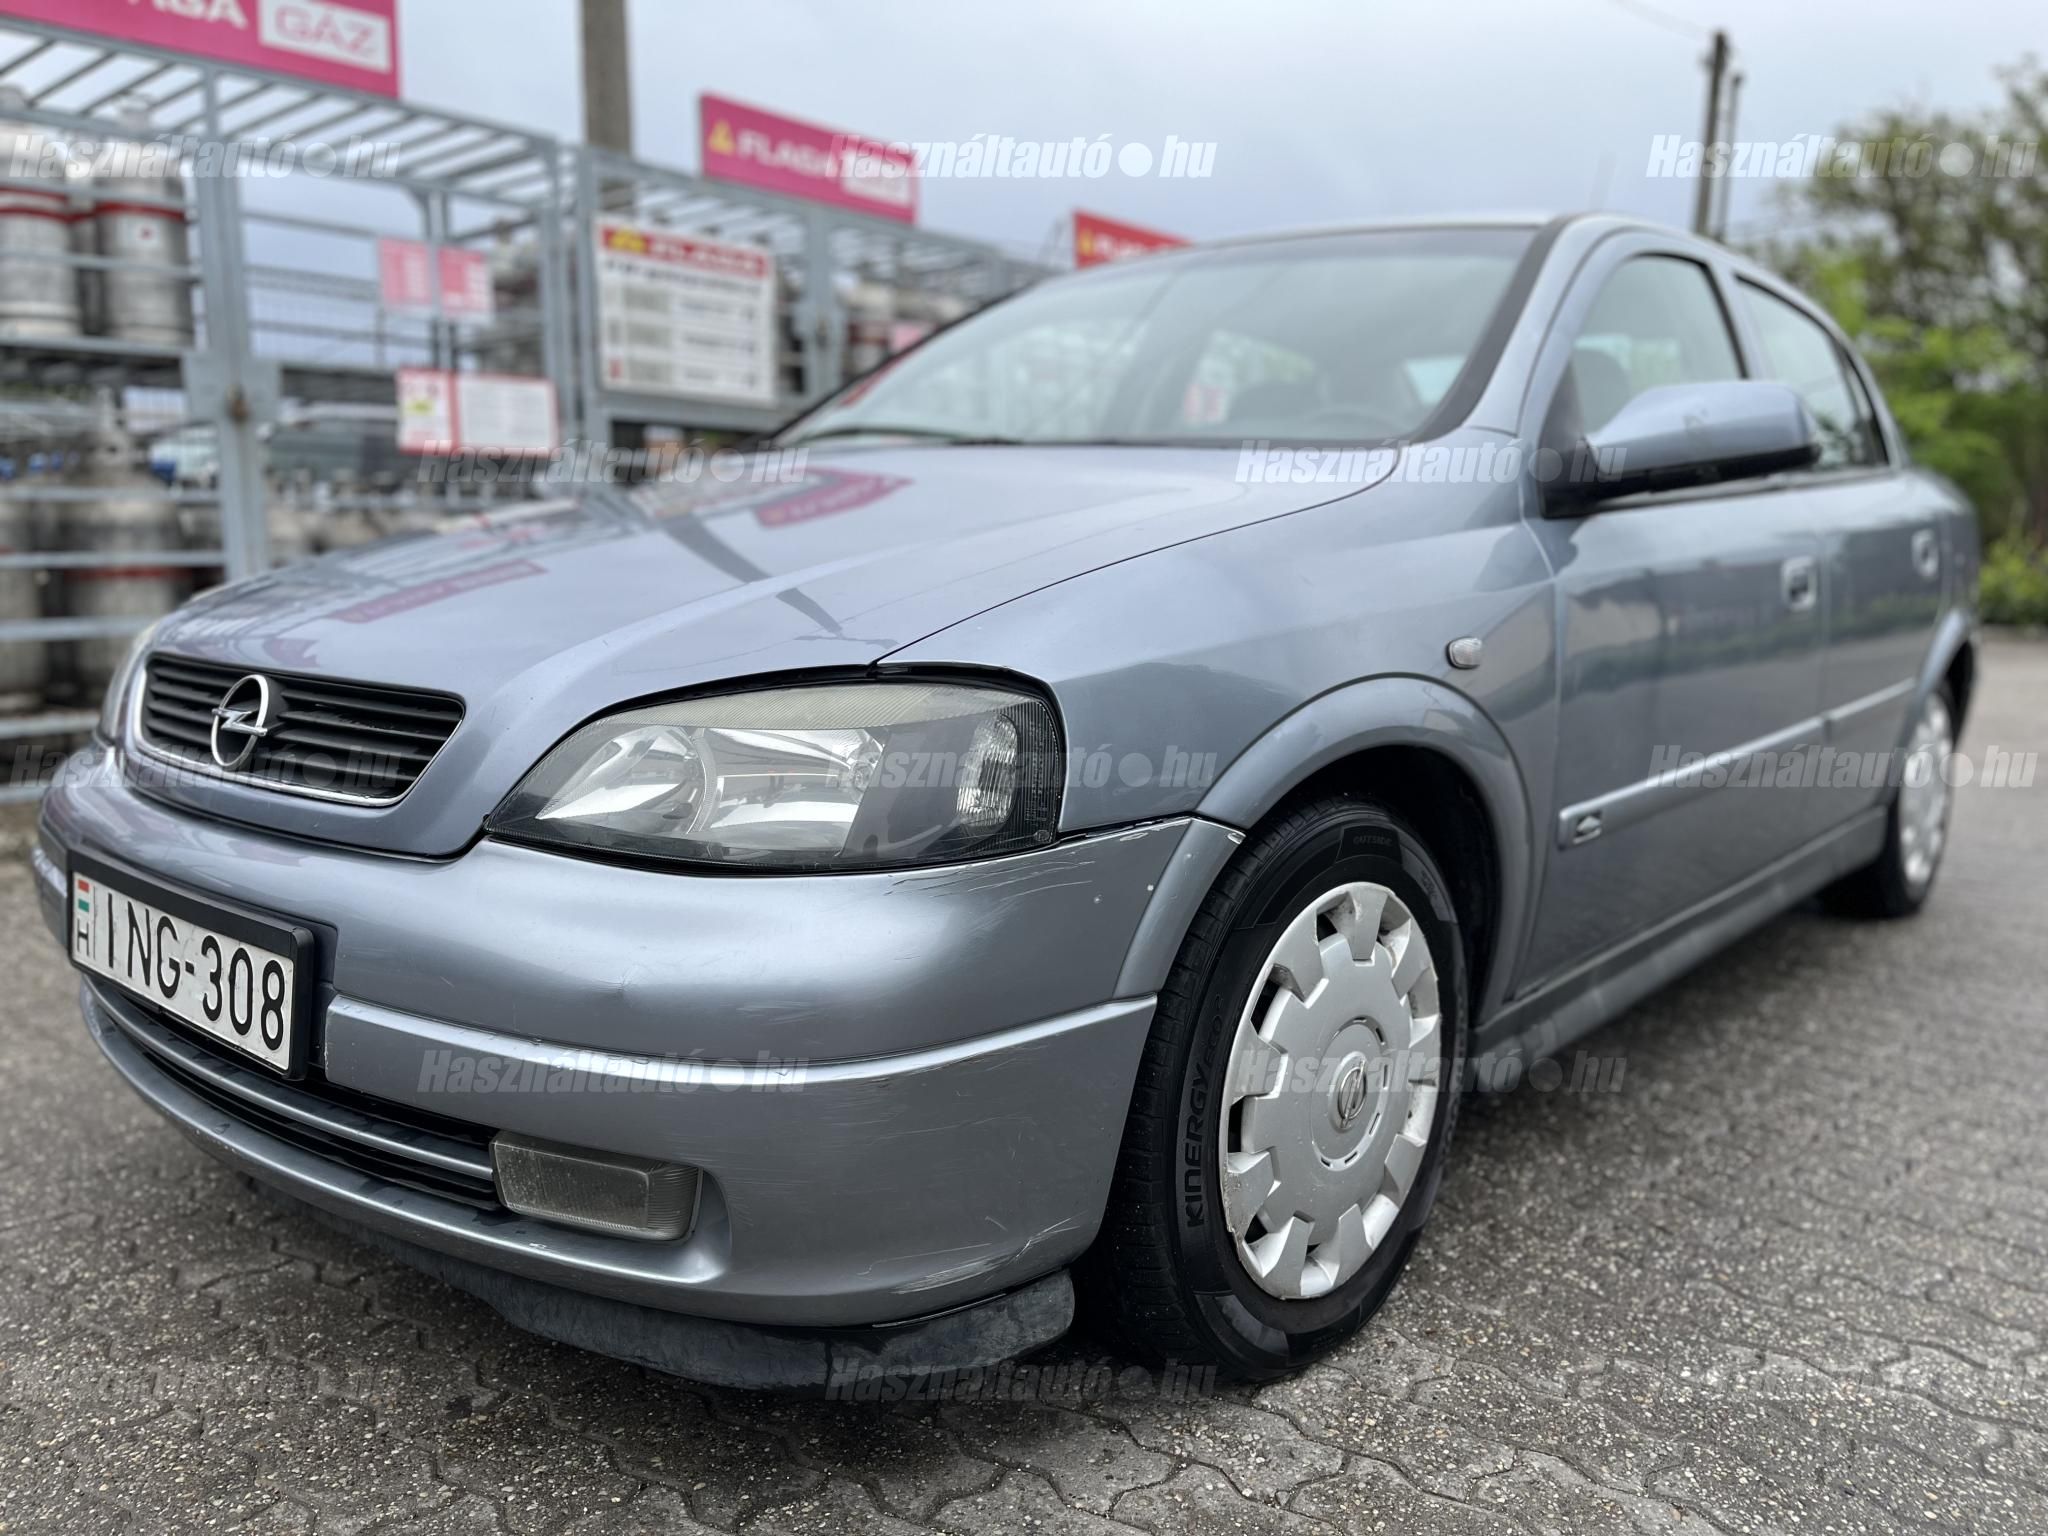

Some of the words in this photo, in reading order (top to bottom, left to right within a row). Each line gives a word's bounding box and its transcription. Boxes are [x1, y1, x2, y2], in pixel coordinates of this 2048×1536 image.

[76, 917, 90, 958] H
[107, 892, 286, 1051] ING-308
[1184, 1060, 1209, 1228] KINERGY
